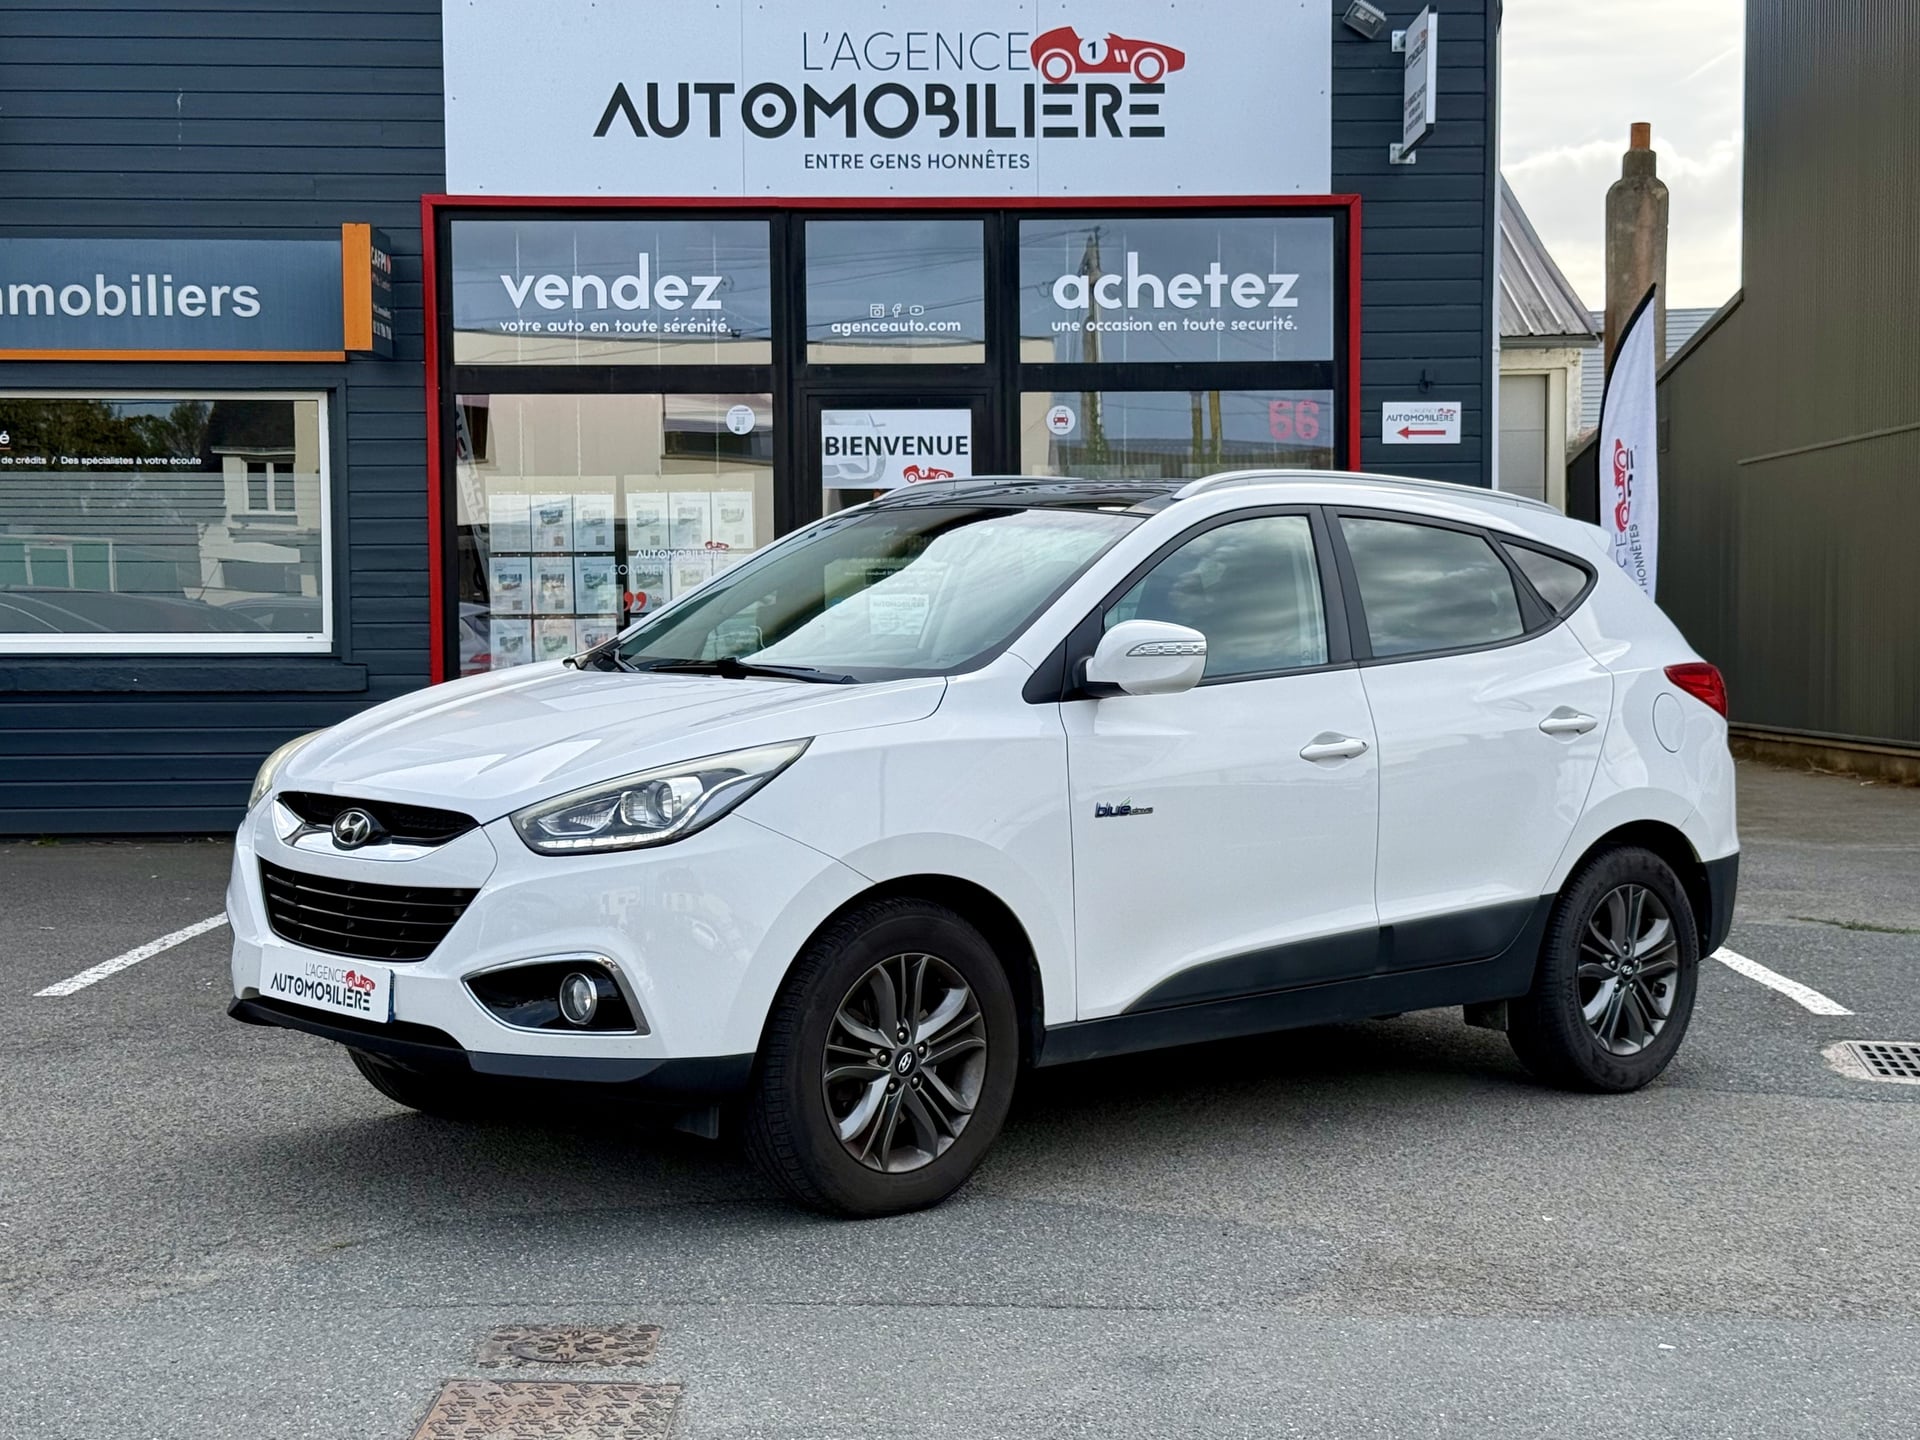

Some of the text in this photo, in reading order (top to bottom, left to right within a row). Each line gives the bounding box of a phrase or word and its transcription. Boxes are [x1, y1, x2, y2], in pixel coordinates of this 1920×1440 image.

[802, 31, 1031, 71] L'AGENCE
[592, 80, 1166, 139] AUTOMOBILIERE
[804, 148, 1030, 169] ENTRE GENS HONNÊTES
[500, 252, 723, 311] vendez
[1052, 252, 1300, 309] achetez
[500, 317, 731, 333] votre auto en toute sérénité.
[831, 320, 962, 336] agenceauto.com
[1051, 315, 1298, 332] une occasion en toute securité.
[825, 435, 969, 457] BIENVENUE
[1, 456, 13, 465] de
[16, 455, 47, 465] crédits
[61, 456, 79, 465] Des
[82, 455, 134, 467] spécialistes
[144, 457, 168, 465] votre
[170, 455, 202, 465] écoute
[1628, 523, 1648, 587] HONNÊTES
[304, 962, 347, 984] L'AGENCE
[270, 972, 371, 1012] AUTOMOBILIERE
